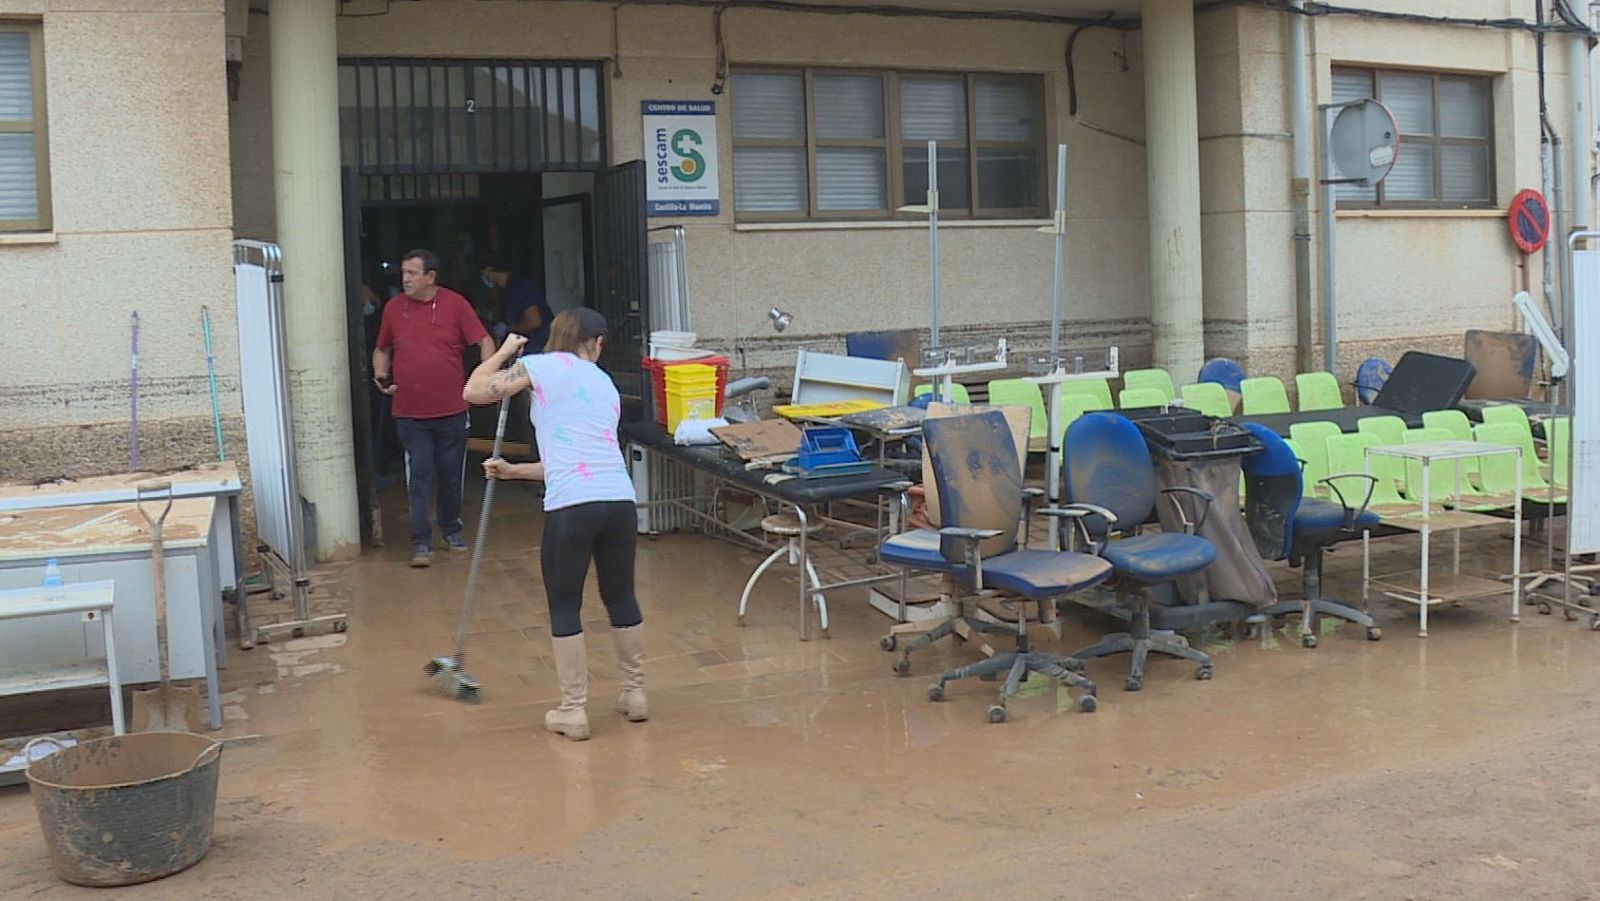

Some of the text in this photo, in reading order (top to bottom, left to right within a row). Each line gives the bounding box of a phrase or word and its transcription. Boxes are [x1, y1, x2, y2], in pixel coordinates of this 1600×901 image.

[467, 99, 475, 113] 2
[648, 104, 711, 112] CENTRO DE SALUD
[657, 128, 668, 183] sescam
